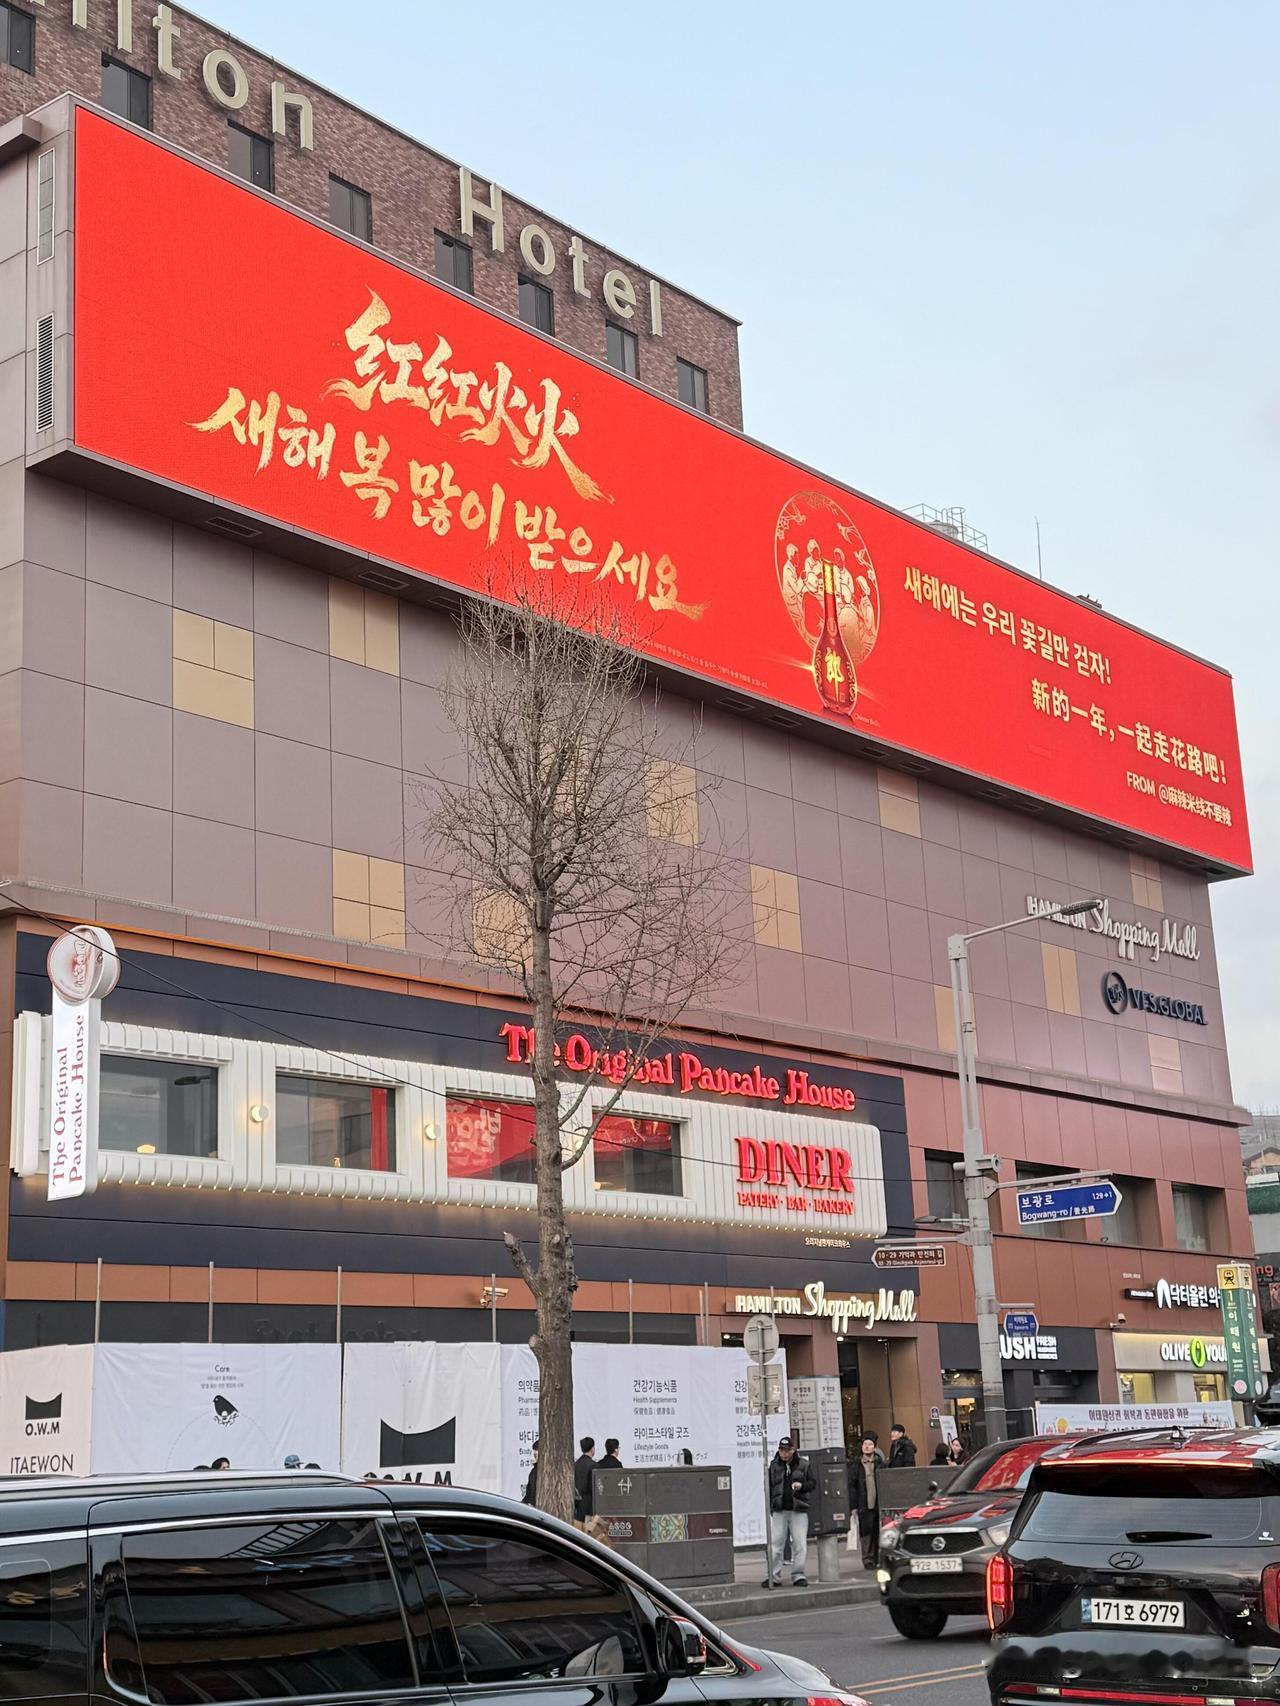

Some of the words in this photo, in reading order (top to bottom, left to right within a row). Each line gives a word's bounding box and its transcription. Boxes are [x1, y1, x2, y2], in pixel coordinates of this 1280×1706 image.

[459, 165, 663, 338] Hotel
[320, 284, 616, 505] 红红火火
[181, 387, 337, 481] 새해
[339, 431, 400, 520] 복
[408, 459, 506, 550] 많이
[514, 499, 706, 621] 받으세요
[903, 566, 977, 628] 새해에는
[982, 601, 1016, 646] 우리
[1020, 617, 1070, 668] 꽃길만
[1073, 643, 1112, 685] 걷자!
[1126, 771, 1156, 797] FROM
[1026, 896, 1088, 930] HAMION
[1089, 899, 1159, 962] Shopping
[1161, 919, 1200, 961] Mall
[70, 1015, 85, 1084] House
[53, 1047, 68, 1136] Original
[679, 1052, 780, 1099] Pancake
[783, 1069, 856, 1111] House
[68, 1092, 83, 1184] Pancake
[52, 1141, 69, 1187] The
[734, 1136, 856, 1193] DINER
[737, 1191, 779, 1209] EATERY
[786, 1195, 808, 1212] BAR
[814, 1198, 855, 1215] BAKERY
[1021, 1194, 1055, 1209] 보광로
[1022, 1208, 1069, 1221] Bogwang-ro
[803, 1281, 874, 1334] Shopping
[874, 1288, 917, 1322] Mall
[999, 1334, 1037, 1360] USH
[1036, 1335, 1057, 1347] FRESH
[1161, 1342, 1191, 1361] OLIVE
[633, 1379, 678, 1393] 건강기능식품
[25, 1421, 60, 1436] O.W.M
[634, 1426, 675, 1440] 라이프스타일
[676, 1426, 690, 1439] 굿즈
[10, 1453, 74, 1474] ITAEWON
[1093, 1601, 1135, 1621] 171호
[1139, 1604, 1180, 1623] 6979
